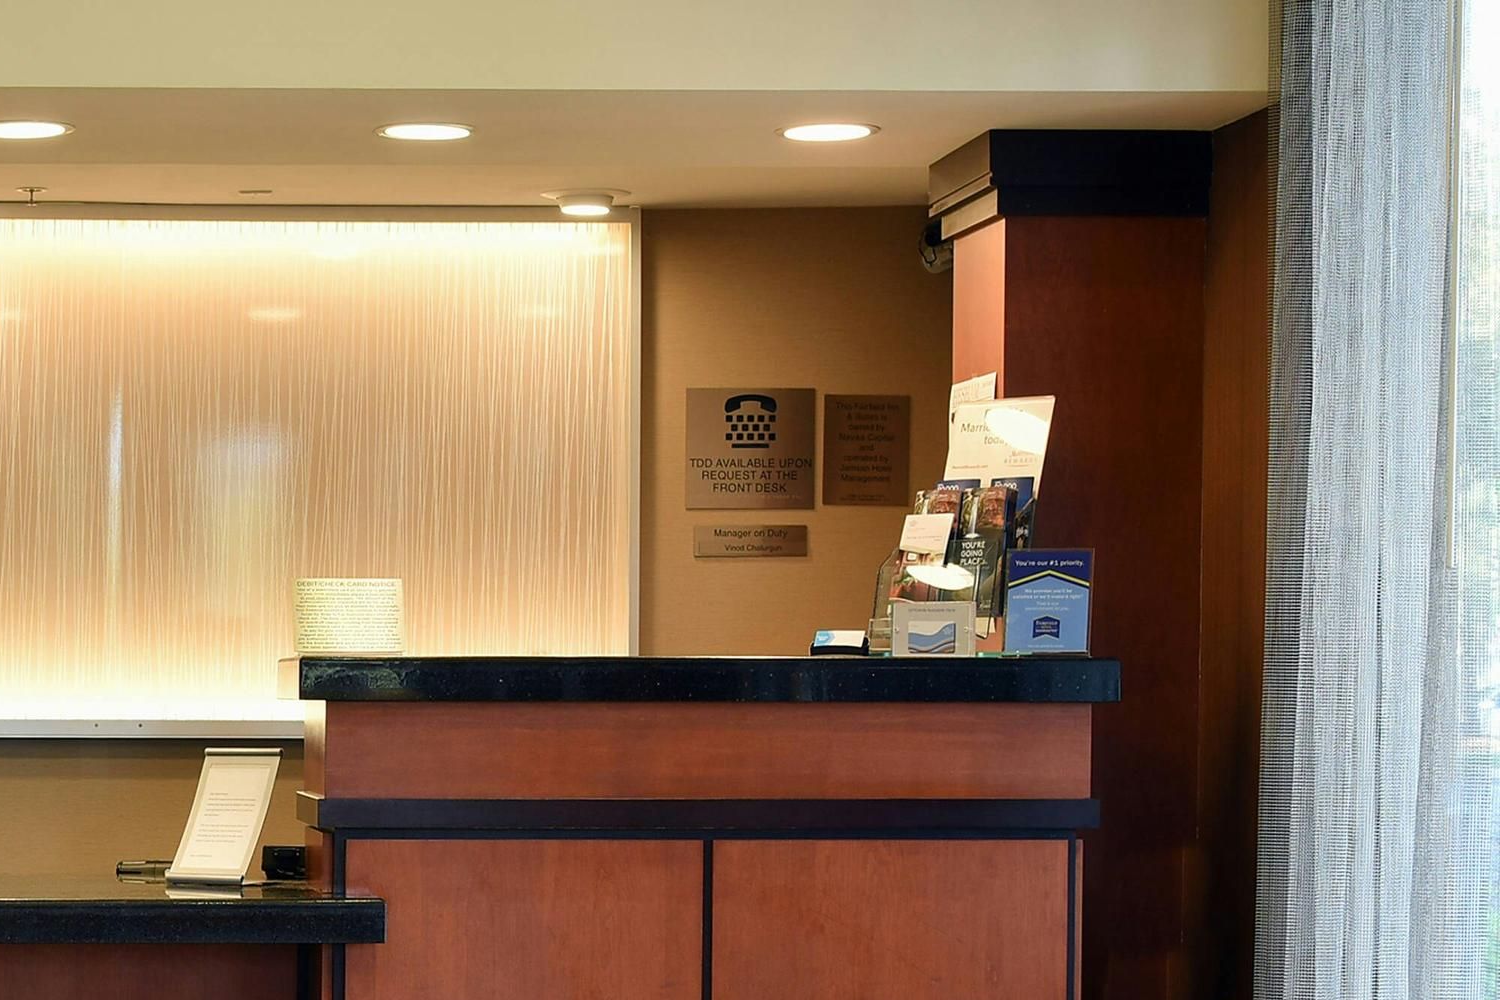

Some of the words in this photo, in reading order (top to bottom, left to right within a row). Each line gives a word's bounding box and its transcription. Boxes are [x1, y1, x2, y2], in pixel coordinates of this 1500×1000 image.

[689, 458, 713, 468] TDD
[716, 458, 775, 468] AVAILABLE
[778, 458, 813, 468] UPON
[701, 470, 757, 480] REQUEST
[760, 470, 772, 480] AT
[776, 470, 798, 480] THE
[712, 482, 752, 493] FRONT
[755, 482, 788, 493] DESK
[713, 529, 751, 539] Manager
[767, 529, 788, 539] Duty
[961, 540, 985, 549] YOU'RE
[960, 548, 984, 557] GOING
